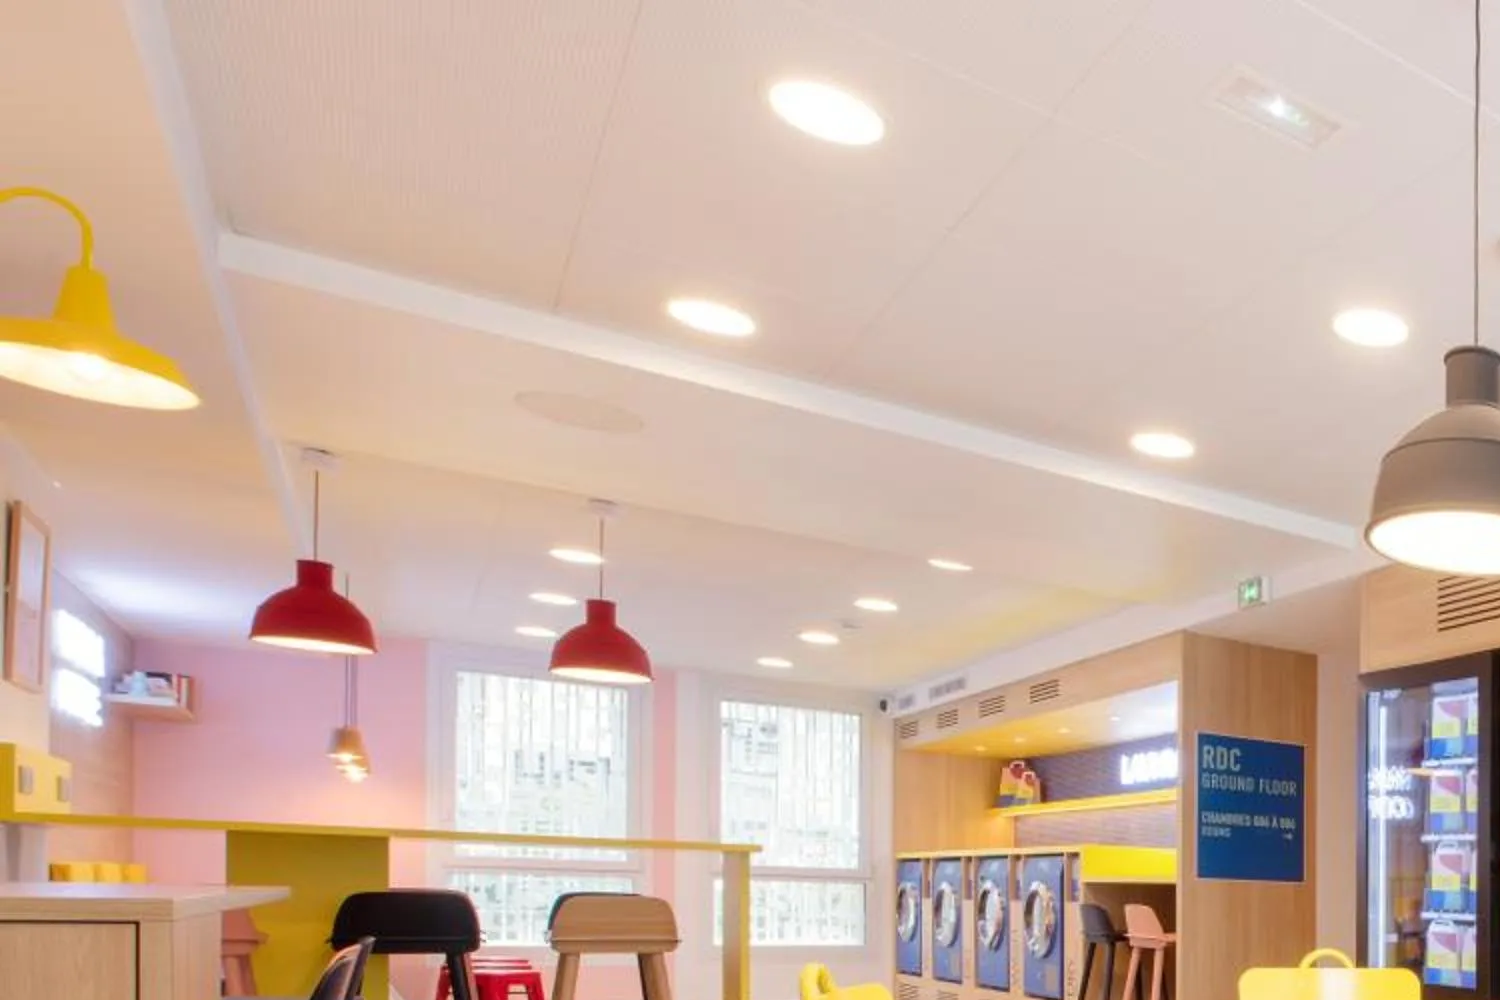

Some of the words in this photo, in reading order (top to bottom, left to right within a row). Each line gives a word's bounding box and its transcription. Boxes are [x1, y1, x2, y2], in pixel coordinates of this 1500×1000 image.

[1202, 744, 1241, 772] RDC
[1201, 771, 1255, 793] GROUND
[1259, 778, 1297, 797] FLOOR
